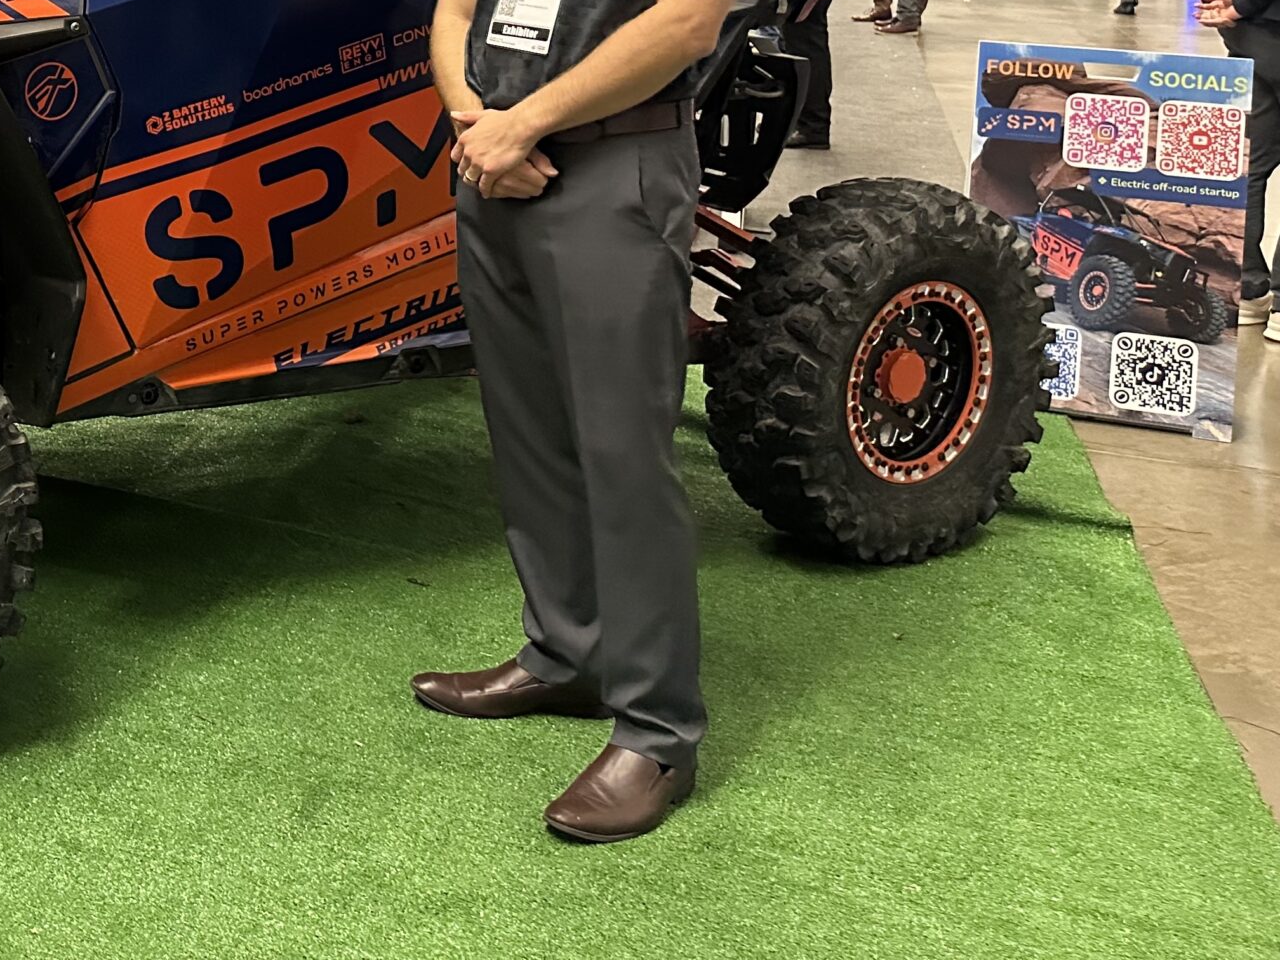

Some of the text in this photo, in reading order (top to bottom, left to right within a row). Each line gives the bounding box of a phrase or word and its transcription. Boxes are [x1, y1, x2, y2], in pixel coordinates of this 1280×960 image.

[502, 25, 539, 39] Exhibitor
[985, 58, 1074, 81] FOLLOW
[243, 63, 333, 103] boardnamics
[1149, 71, 1248, 94] SOCIALS
[166, 103, 235, 131] SOLUTIONS
[173, 95, 227, 117] BATTERY
[1006, 114, 1056, 132] SPM
[1110, 177, 1240, 200] Electric off-road startup
[145, 107, 457, 310] SPM
[1040, 234, 1077, 267] SPM
[186, 232, 455, 351] SUPER POWERS MOBIL
